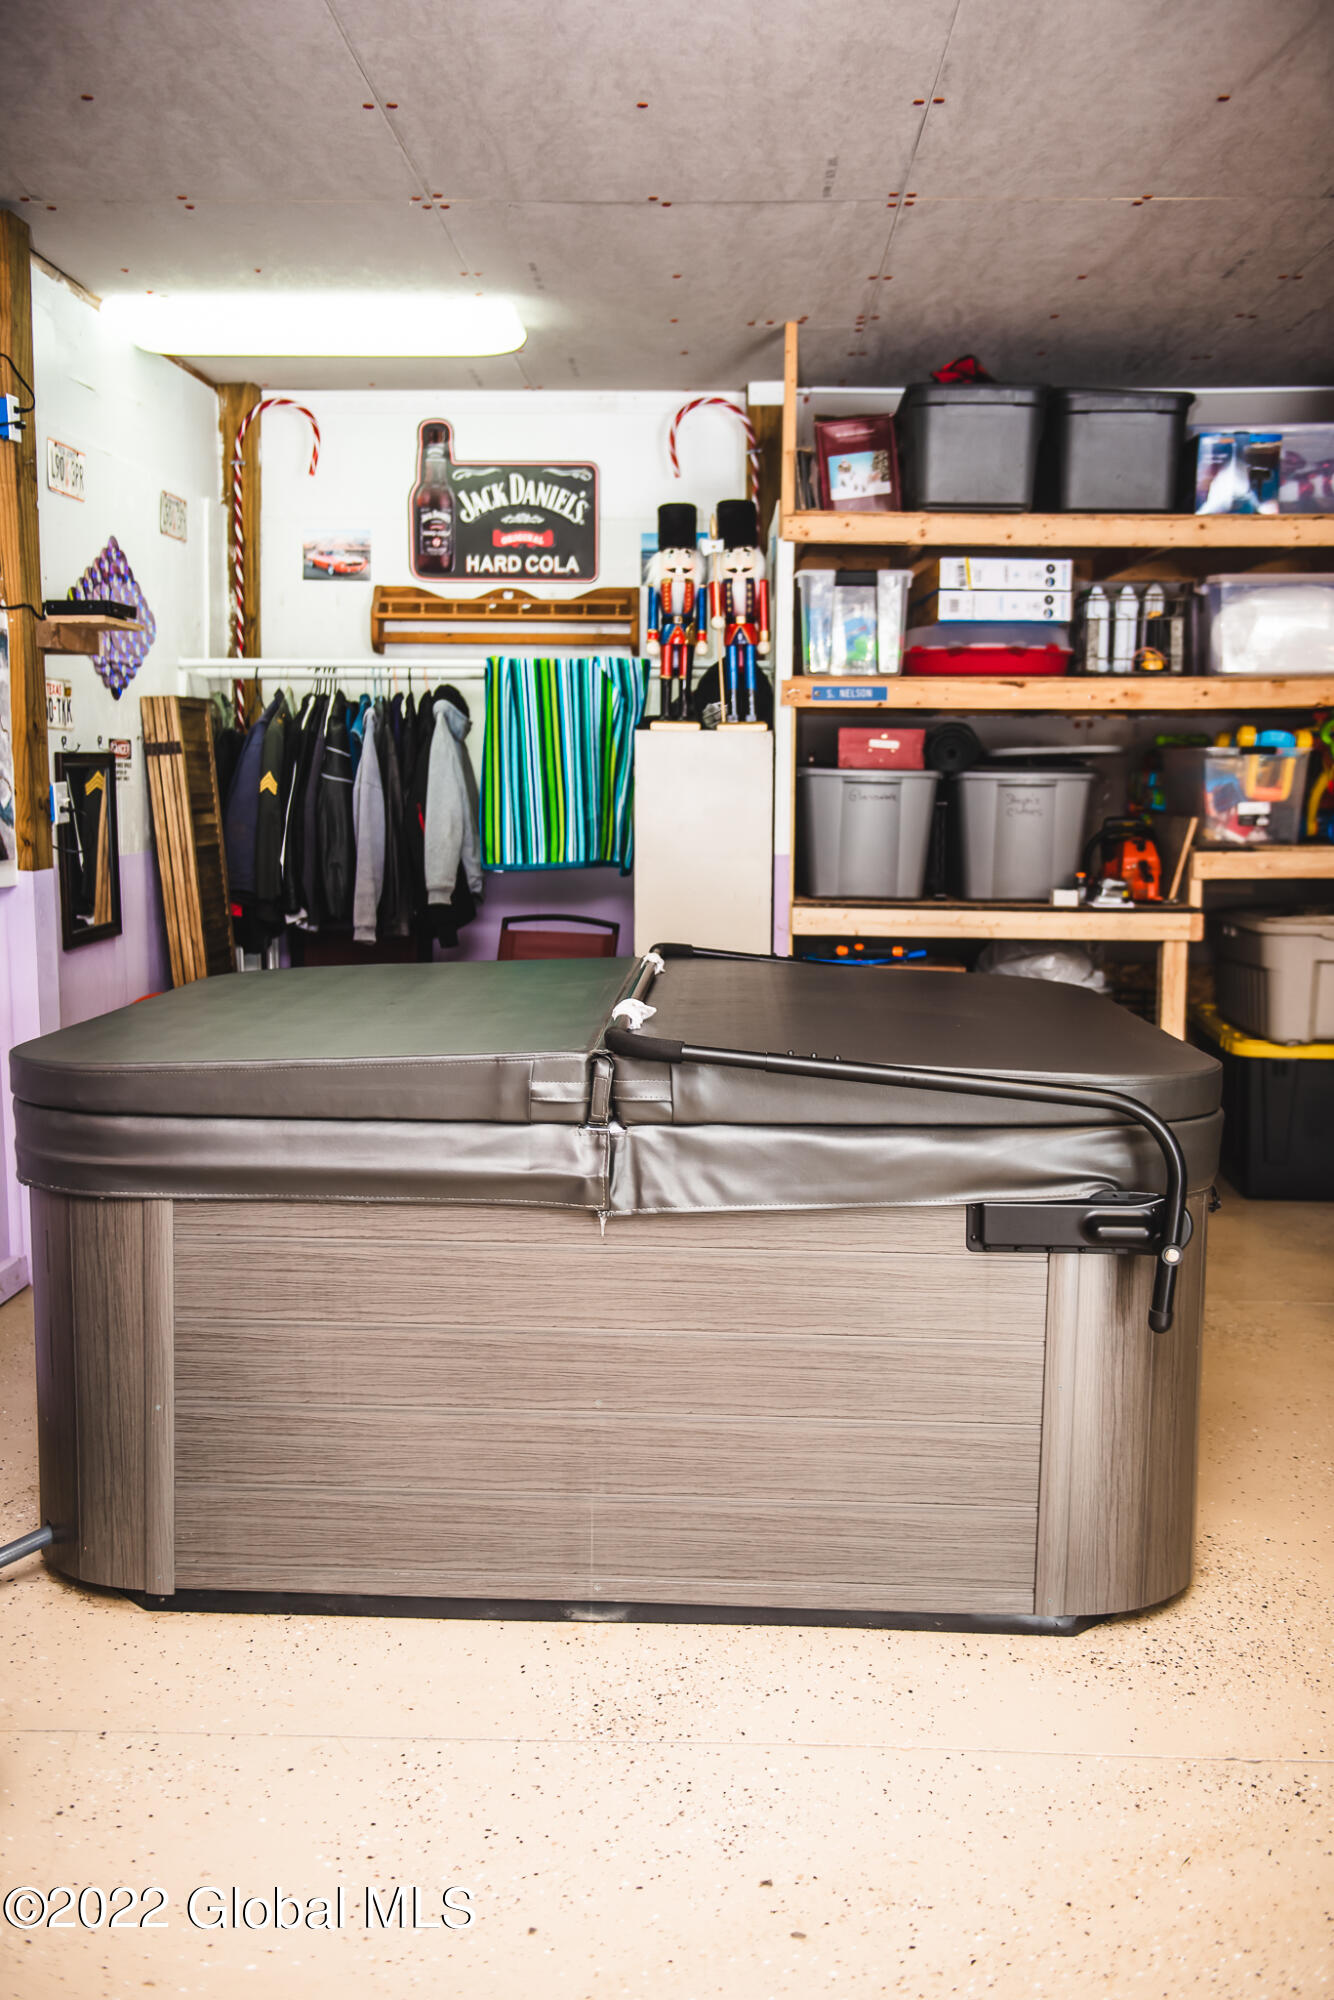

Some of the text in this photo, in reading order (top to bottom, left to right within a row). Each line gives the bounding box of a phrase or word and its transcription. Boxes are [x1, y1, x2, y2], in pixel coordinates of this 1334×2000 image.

[457, 472, 590, 523] JACK DANIEL'S
[501, 533, 545, 545] ORIGINAL
[465, 555, 580, 574] HARD COLA
[46, 682, 62, 696] TEXAS
[839, 688, 873, 698] NELSON
